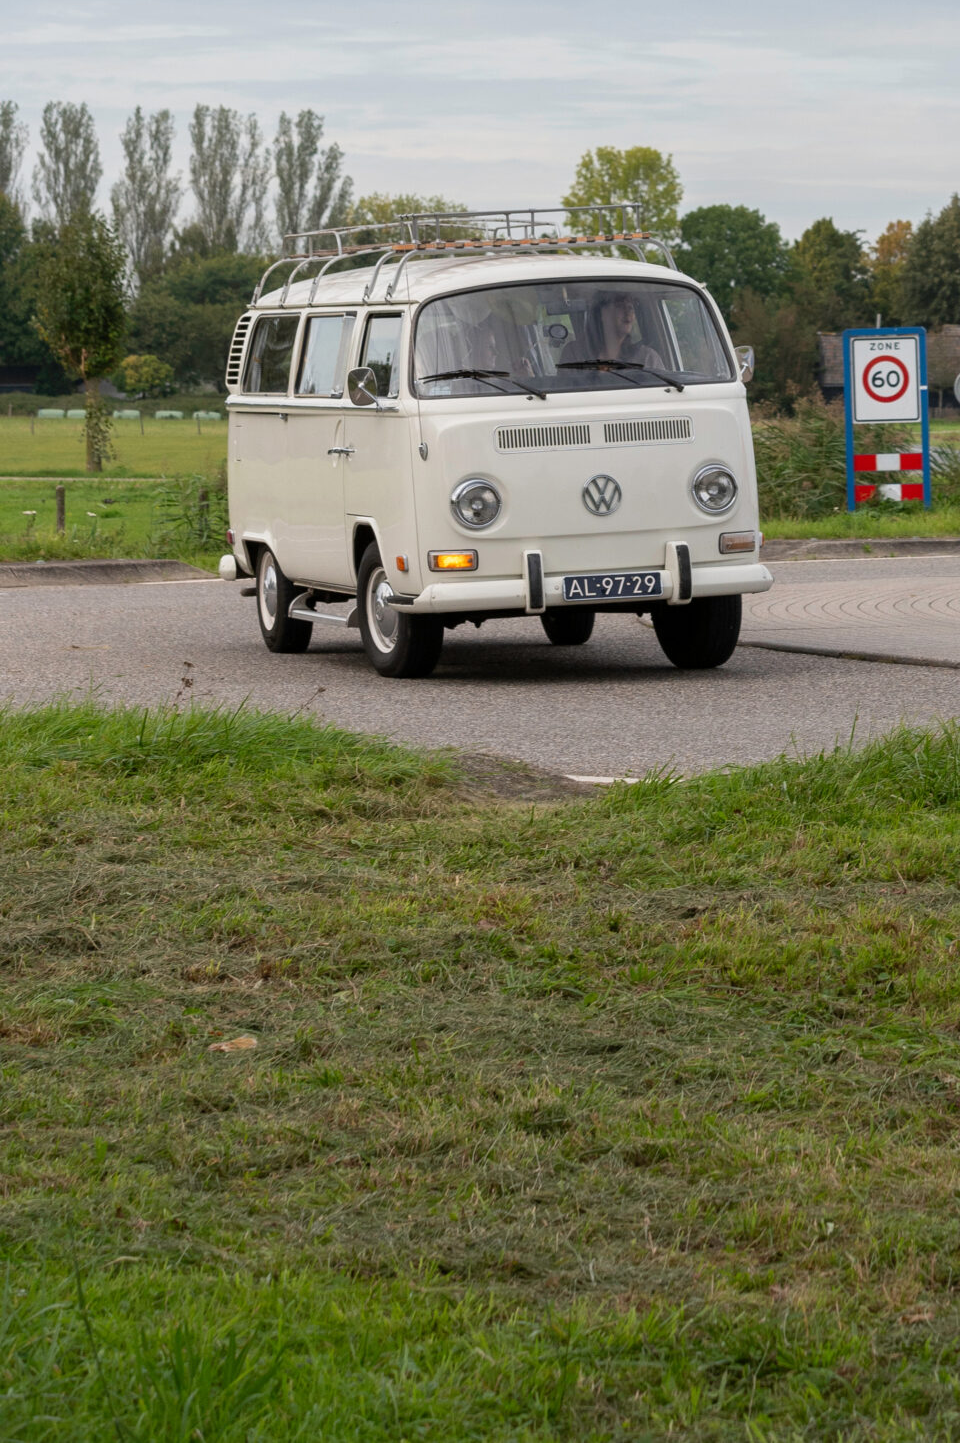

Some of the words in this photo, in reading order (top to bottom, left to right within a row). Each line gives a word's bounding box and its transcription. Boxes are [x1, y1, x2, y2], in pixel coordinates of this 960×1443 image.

[869, 342, 900, 351] ZONE
[872, 370, 900, 388] 60
[583, 475, 621, 515] VW
[569, 575, 656, 597] AL-97-29
